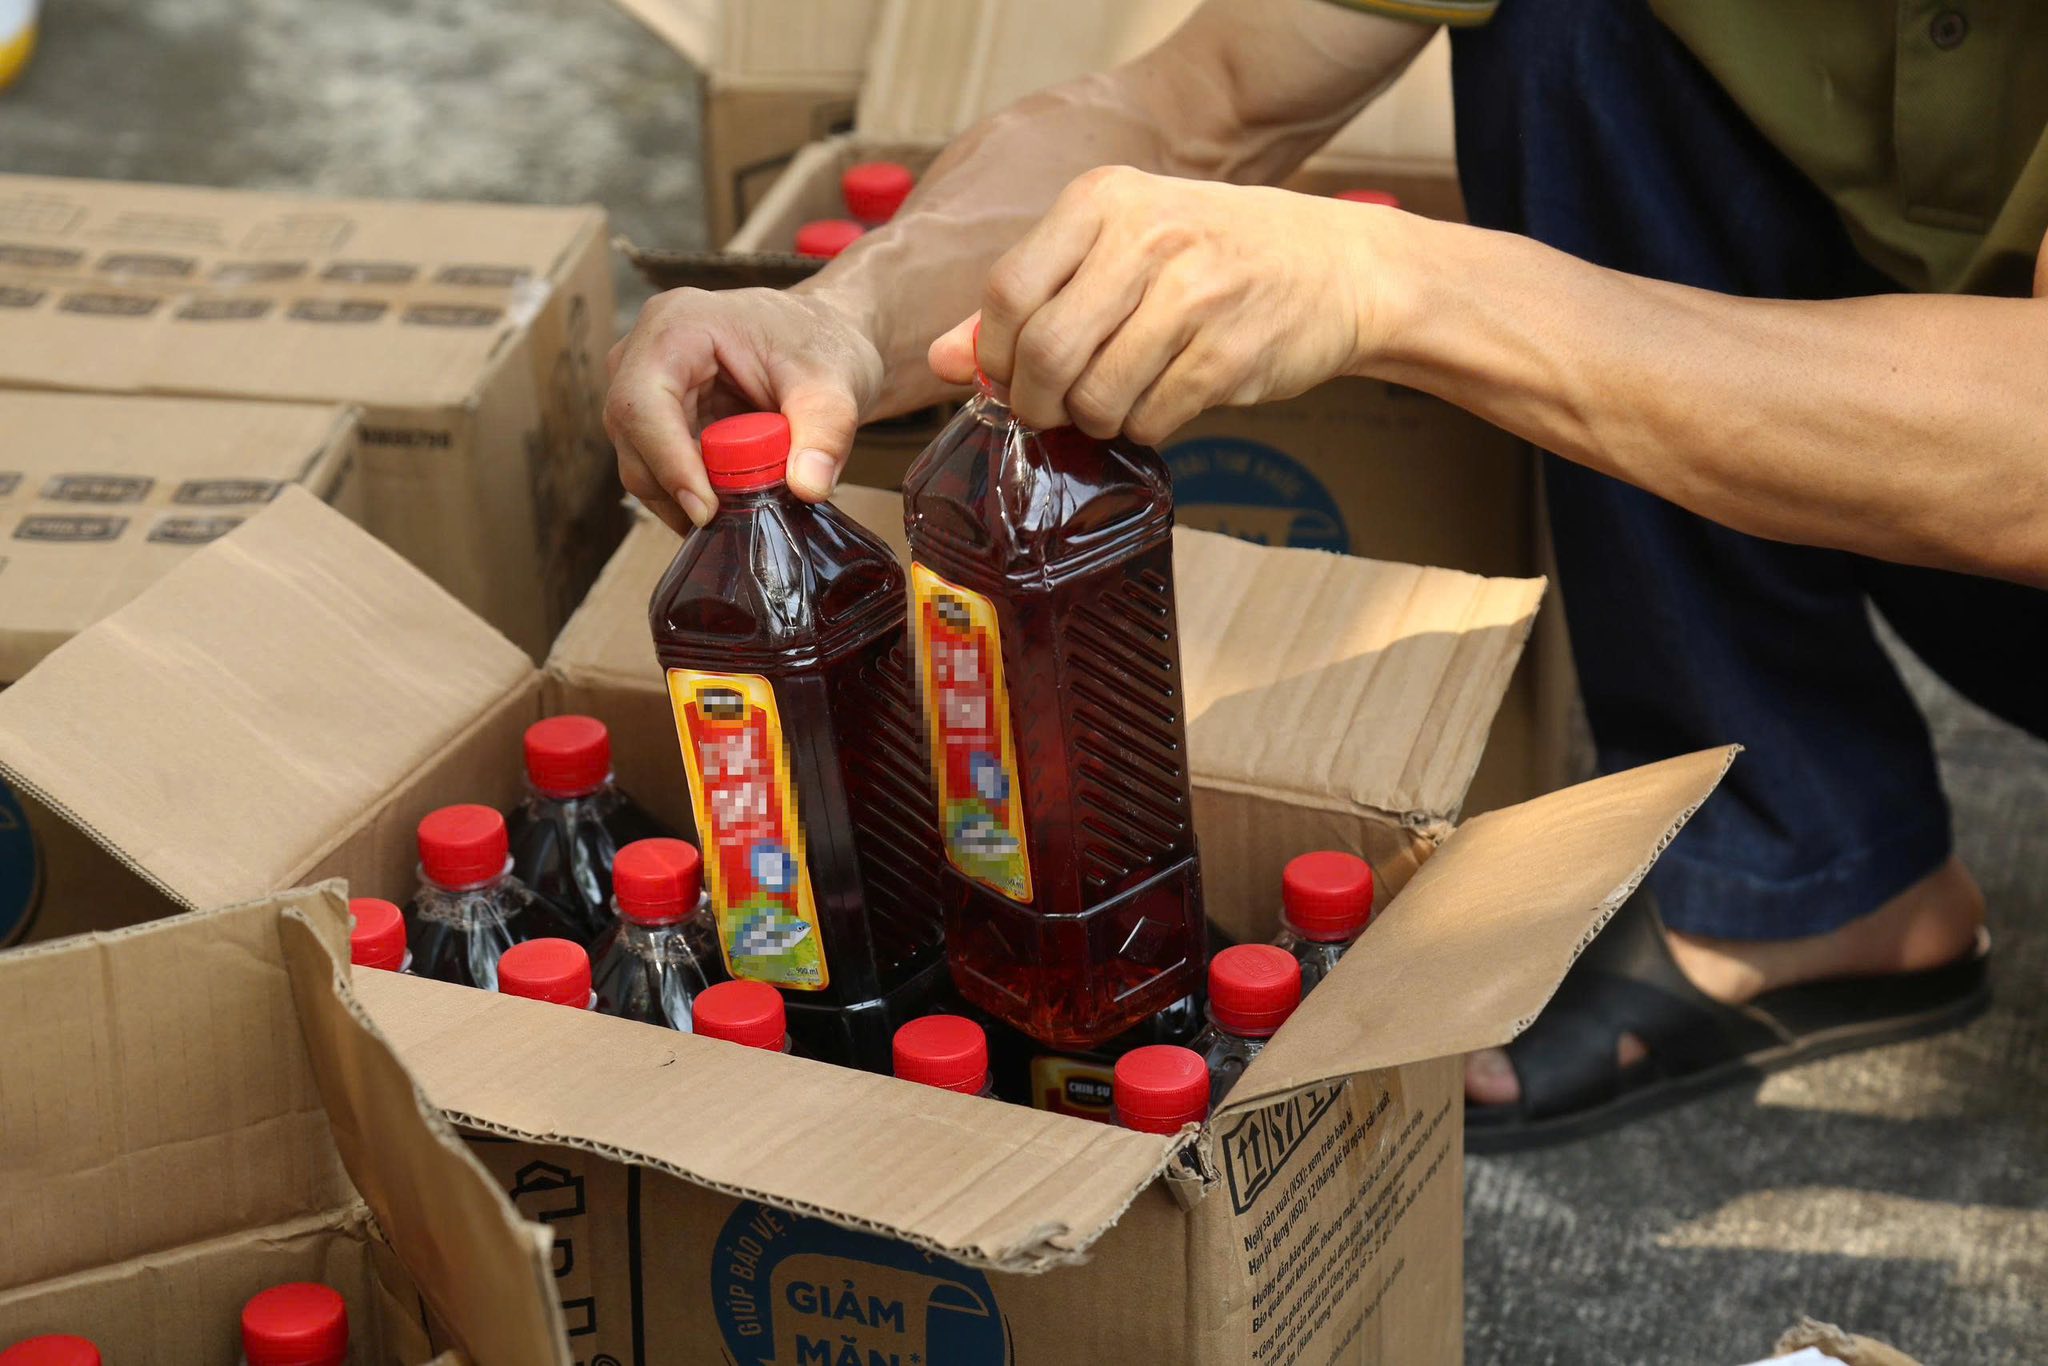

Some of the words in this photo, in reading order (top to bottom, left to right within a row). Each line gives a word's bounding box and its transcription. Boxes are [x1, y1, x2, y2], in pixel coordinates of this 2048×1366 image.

[1068, 1081, 1111, 1097] CHIN-SU
[1244, 1225, 1263, 1252] Ngày
[1262, 1210, 1276, 1231] sản
[1275, 1188, 1290, 1216] xuất
[1289, 1167, 1311, 1199] (NSX):
[1308, 1151, 1322, 1174] xem
[1321, 1134, 1335, 1156] trên
[1334, 1120, 1347, 1140] bao
[1248, 1253, 1265, 1276] Hạn
[1264, 1239, 1272, 1261] sử
[1272, 1222, 1290, 1248] dụng
[1288, 1196, 1308, 1228] (HSD):
[1307, 1183, 1317, 1201] 12
[1315, 1162, 1336, 1191] tháng
[1350, 1124, 1366, 1149] ngày
[727, 1236, 763, 1281] BẢO
[1252, 1278, 1276, 1310] Hướng
[1289, 1245, 1301, 1267] bảo
[1301, 1222, 1320, 1252] quản:
[1252, 1312, 1267, 1334] Bảo
[1268, 1290, 1284, 1318] quản
[1284, 1276, 1295, 1296] nơi
[1295, 1261, 1308, 1282] khô
[1320, 1216, 1342, 1249] thoáng
[726, 1286, 762, 1336] GIÚP
[785, 1280, 905, 1333] GIẢM
